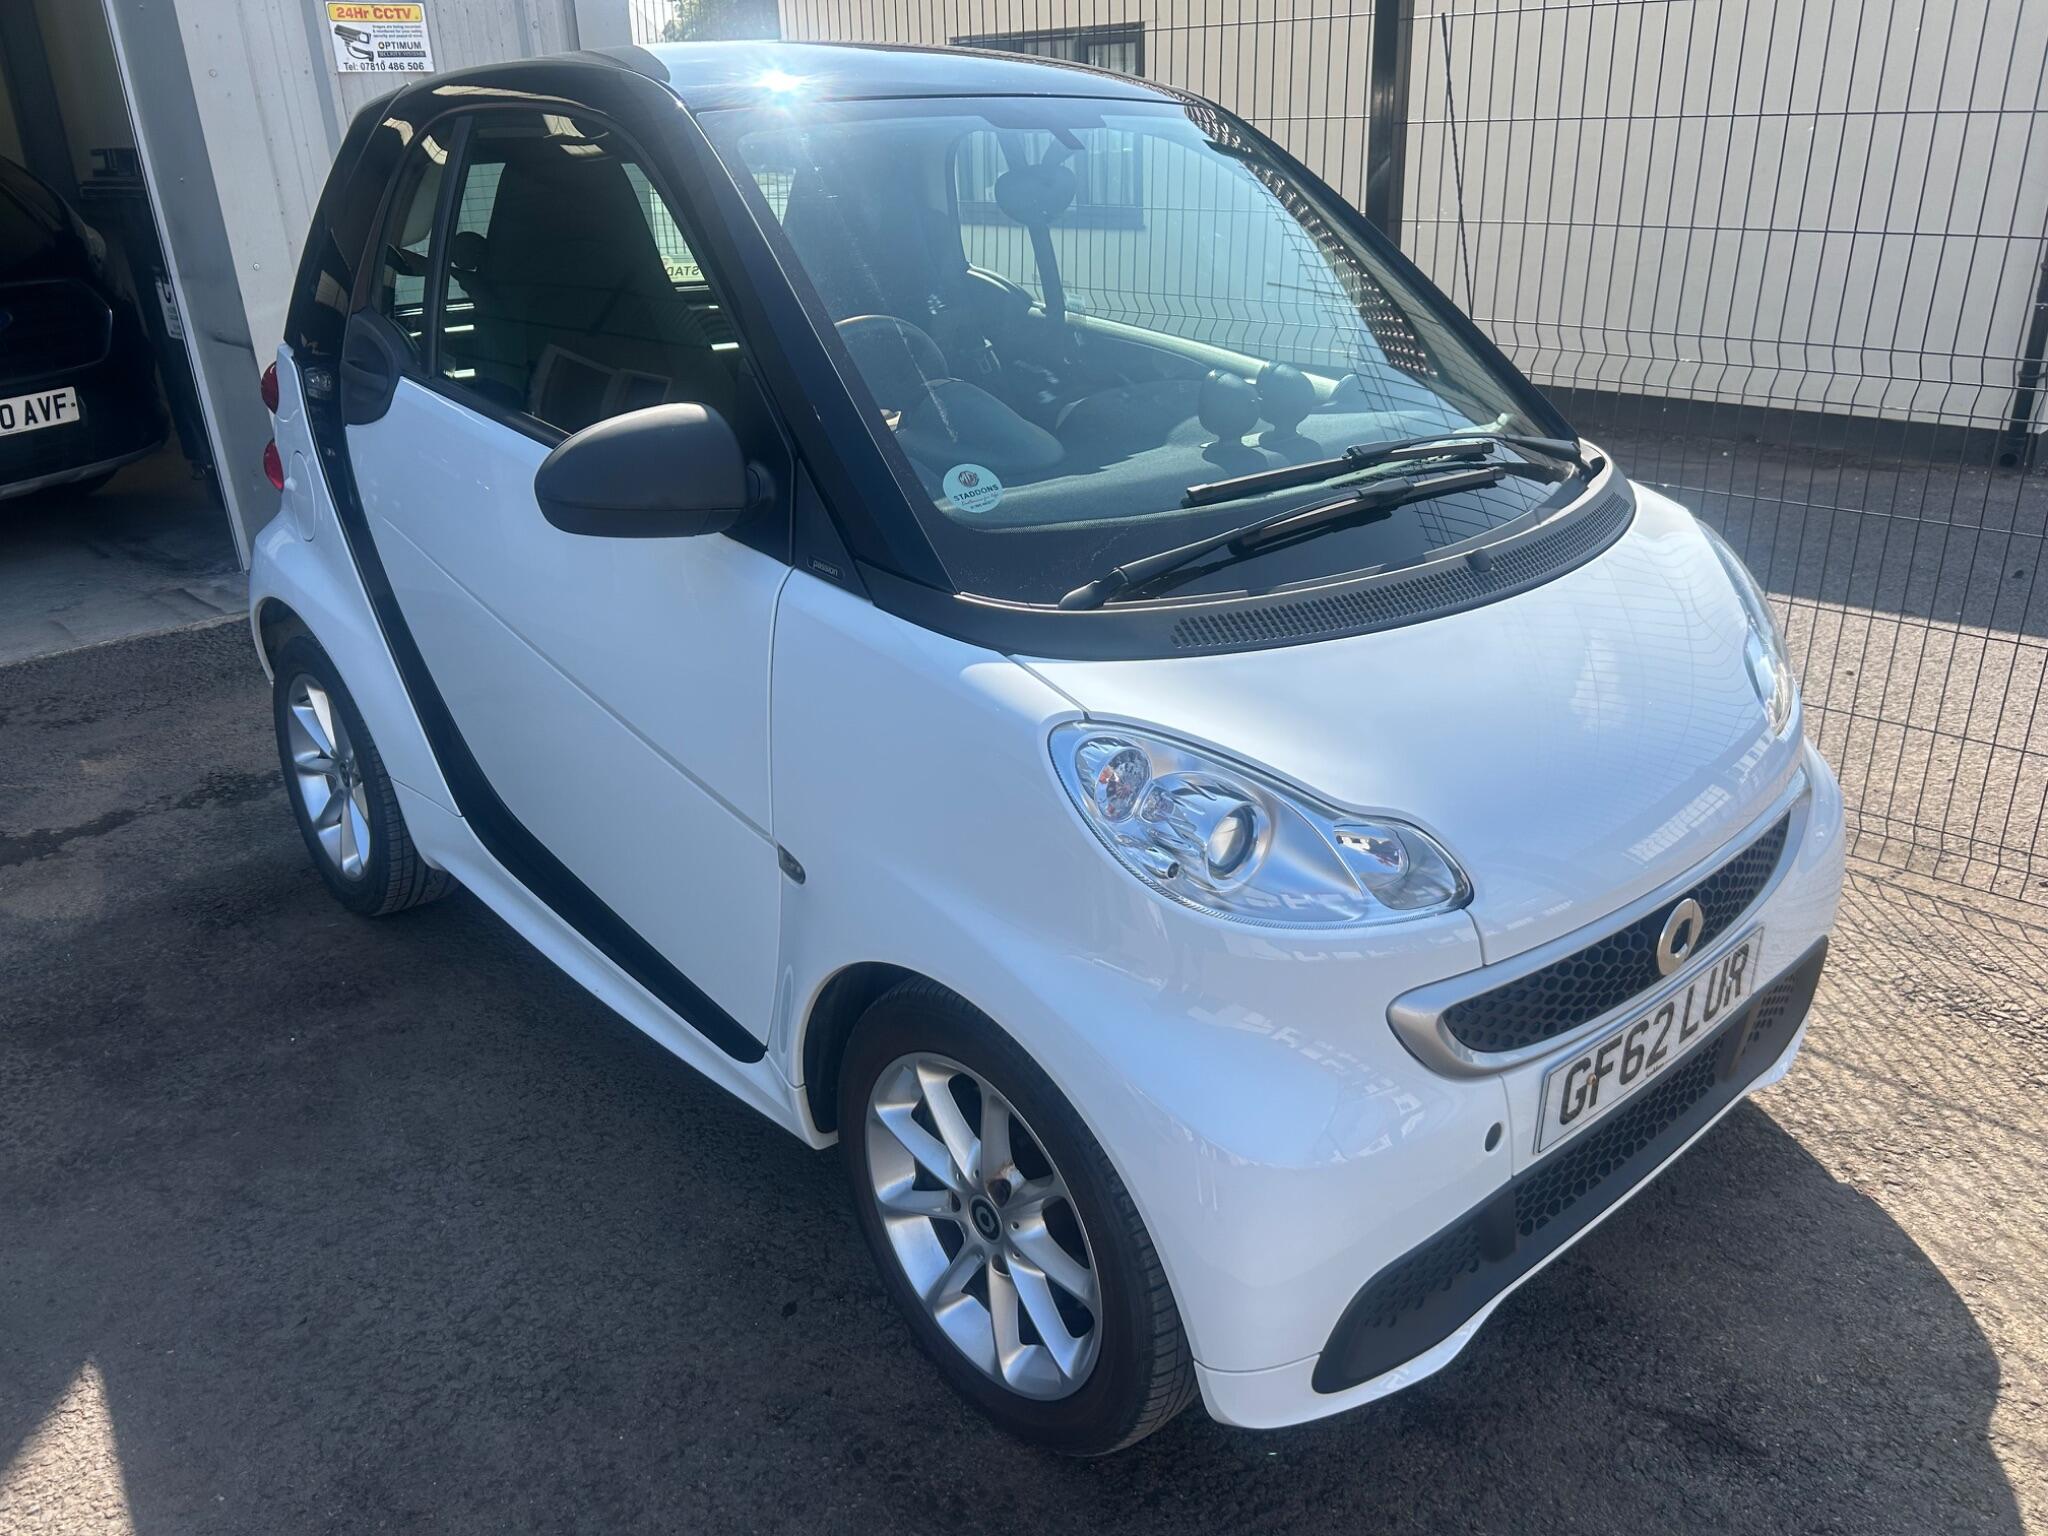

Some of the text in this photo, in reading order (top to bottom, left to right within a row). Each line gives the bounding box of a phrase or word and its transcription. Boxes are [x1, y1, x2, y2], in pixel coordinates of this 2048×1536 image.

[336, 7, 411, 20] 24Hr CCTV
[378, 41, 422, 50] OPTIMUM
[344, 62, 425, 71] Tel: 07810 486 506
[25, 393, 67, 426] AVF
[953, 484, 999, 502] STADDONS
[1559, 943, 1750, 1126] GF62 LUR
